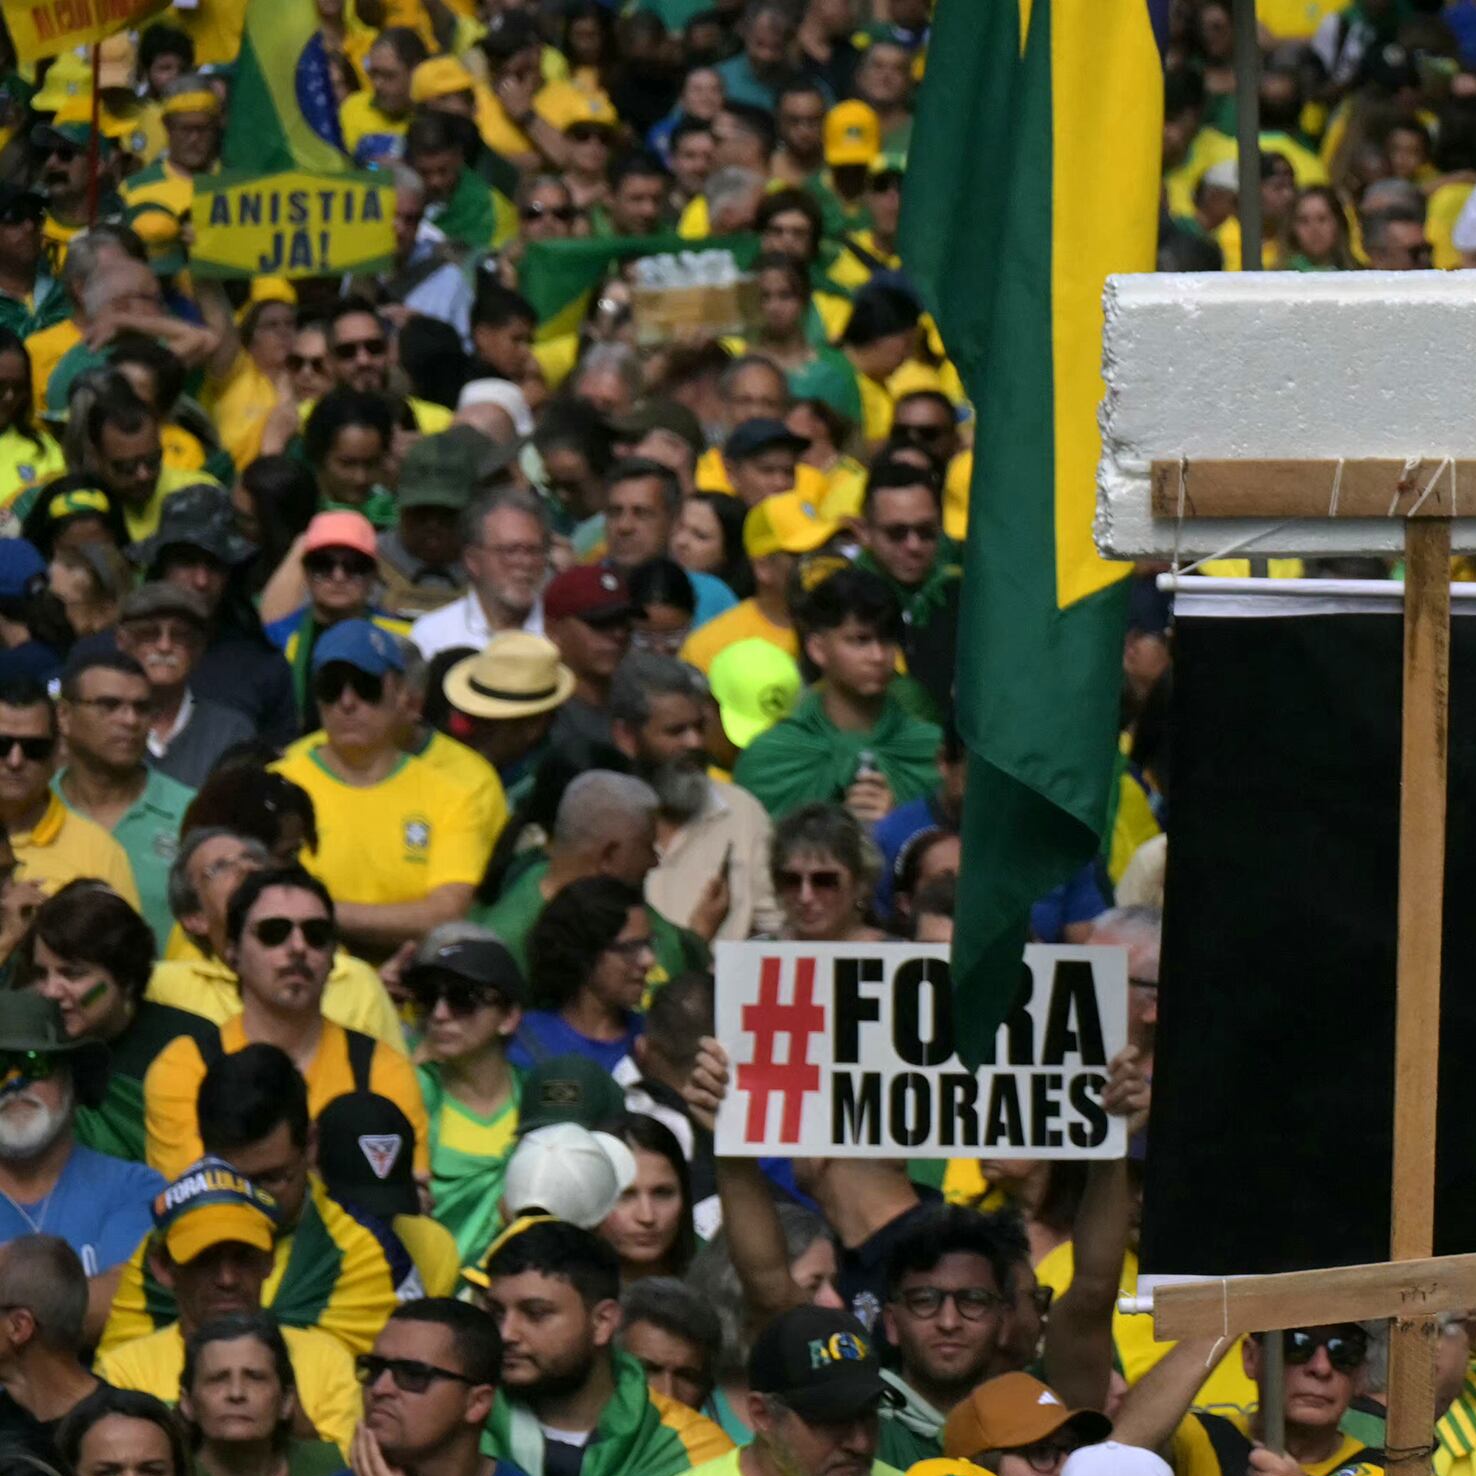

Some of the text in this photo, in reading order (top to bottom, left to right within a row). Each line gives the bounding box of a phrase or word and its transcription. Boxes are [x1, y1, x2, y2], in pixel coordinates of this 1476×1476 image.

[209, 188, 387, 227] ANISTIA
[258, 229, 331, 275] JÁ!
[830, 1071, 1109, 1148] MORAES
